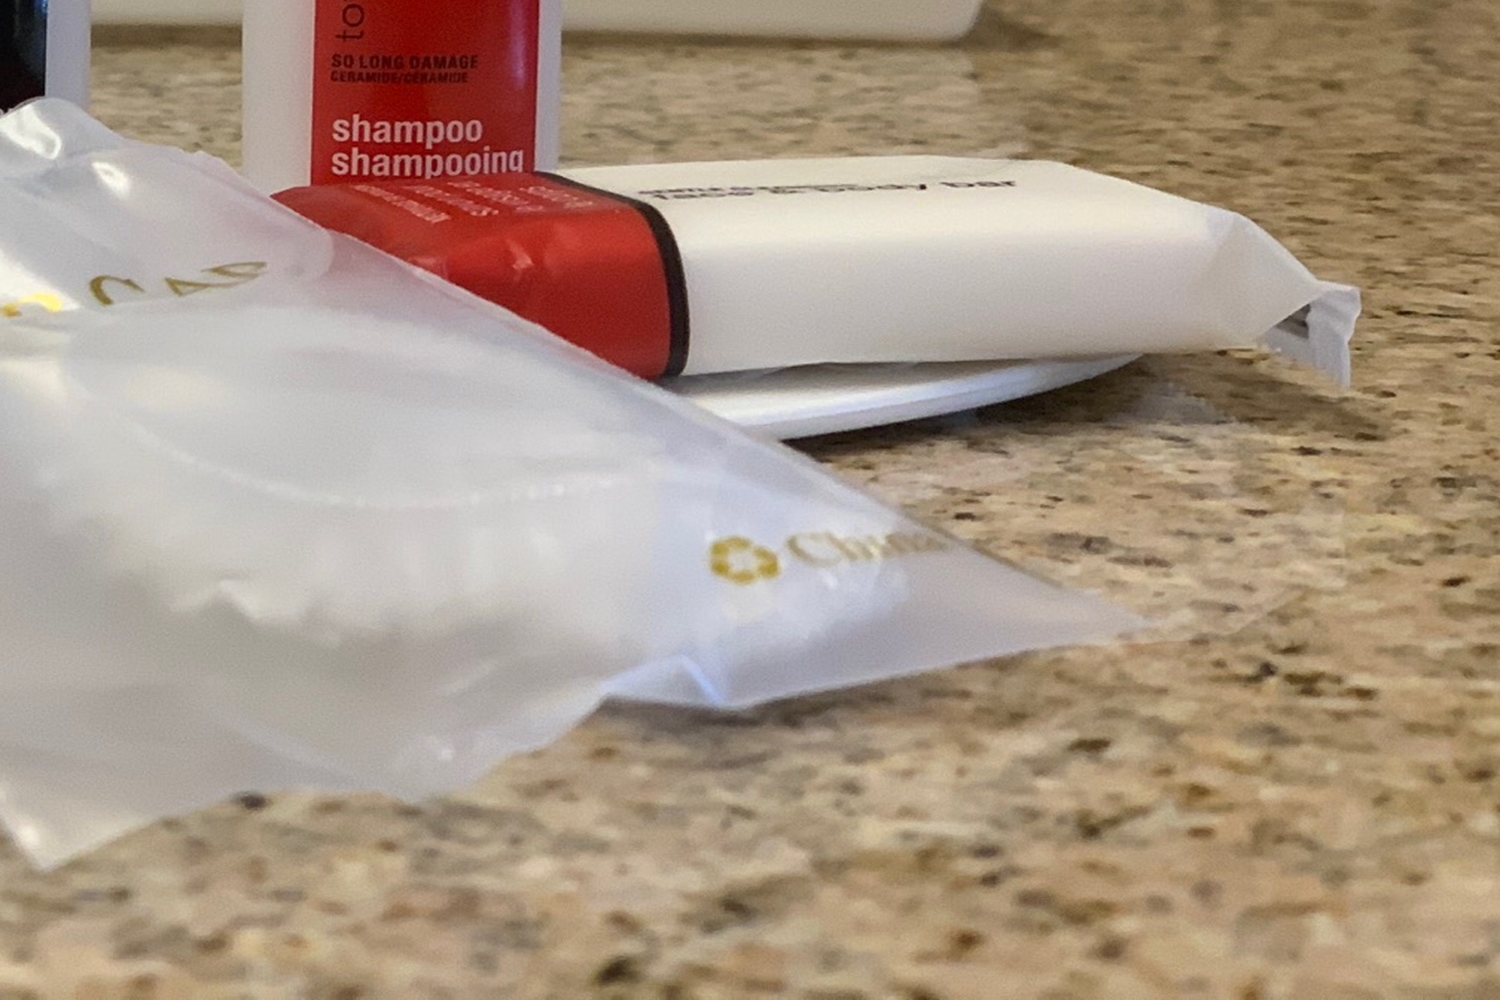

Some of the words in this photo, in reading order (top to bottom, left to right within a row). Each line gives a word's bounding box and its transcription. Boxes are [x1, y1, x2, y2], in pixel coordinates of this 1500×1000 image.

[330, 53, 355, 69] SO
[359, 55, 405, 70] LONG
[409, 55, 479, 70] DAMAGE
[331, 113, 483, 150] shampoo
[330, 145, 525, 180] shampooing
